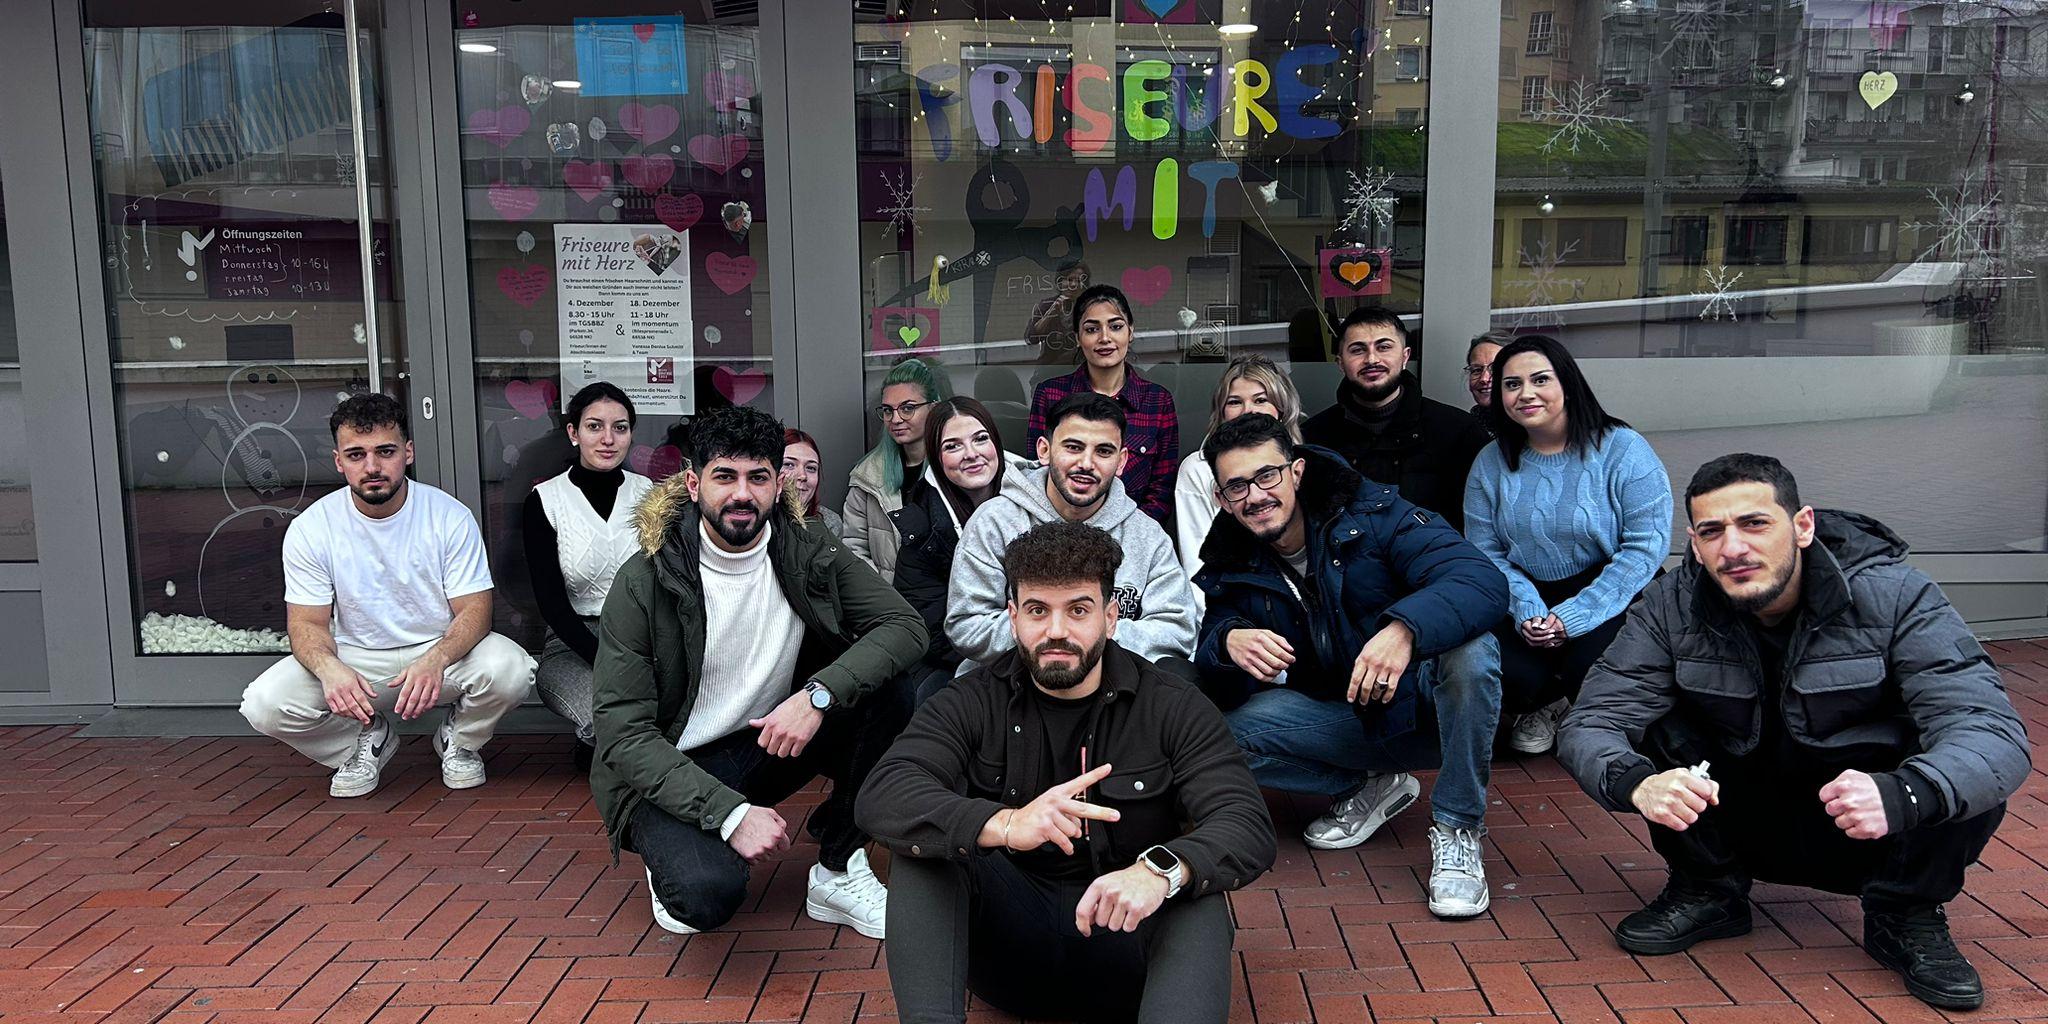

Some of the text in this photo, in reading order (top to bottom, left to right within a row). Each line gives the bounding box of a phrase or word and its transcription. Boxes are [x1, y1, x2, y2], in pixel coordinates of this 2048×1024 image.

[1864, 79, 1886, 91] HERZ
[917, 44, 1341, 162] FRISEURE
[1084, 158, 1239, 242] MIT
[222, 228, 303, 242] Öffnungszeiten
[220, 243, 272, 254] Mittwoch
[561, 236, 630, 253] Friseure
[222, 258, 279, 272] Donnerstag
[561, 255, 635, 271] mit Herz
[1007, 273, 1089, 298] FRISEUR
[643, 300, 680, 308] Dezember
[601, 311, 615, 319] Uhr
[615, 324, 625, 336] &
